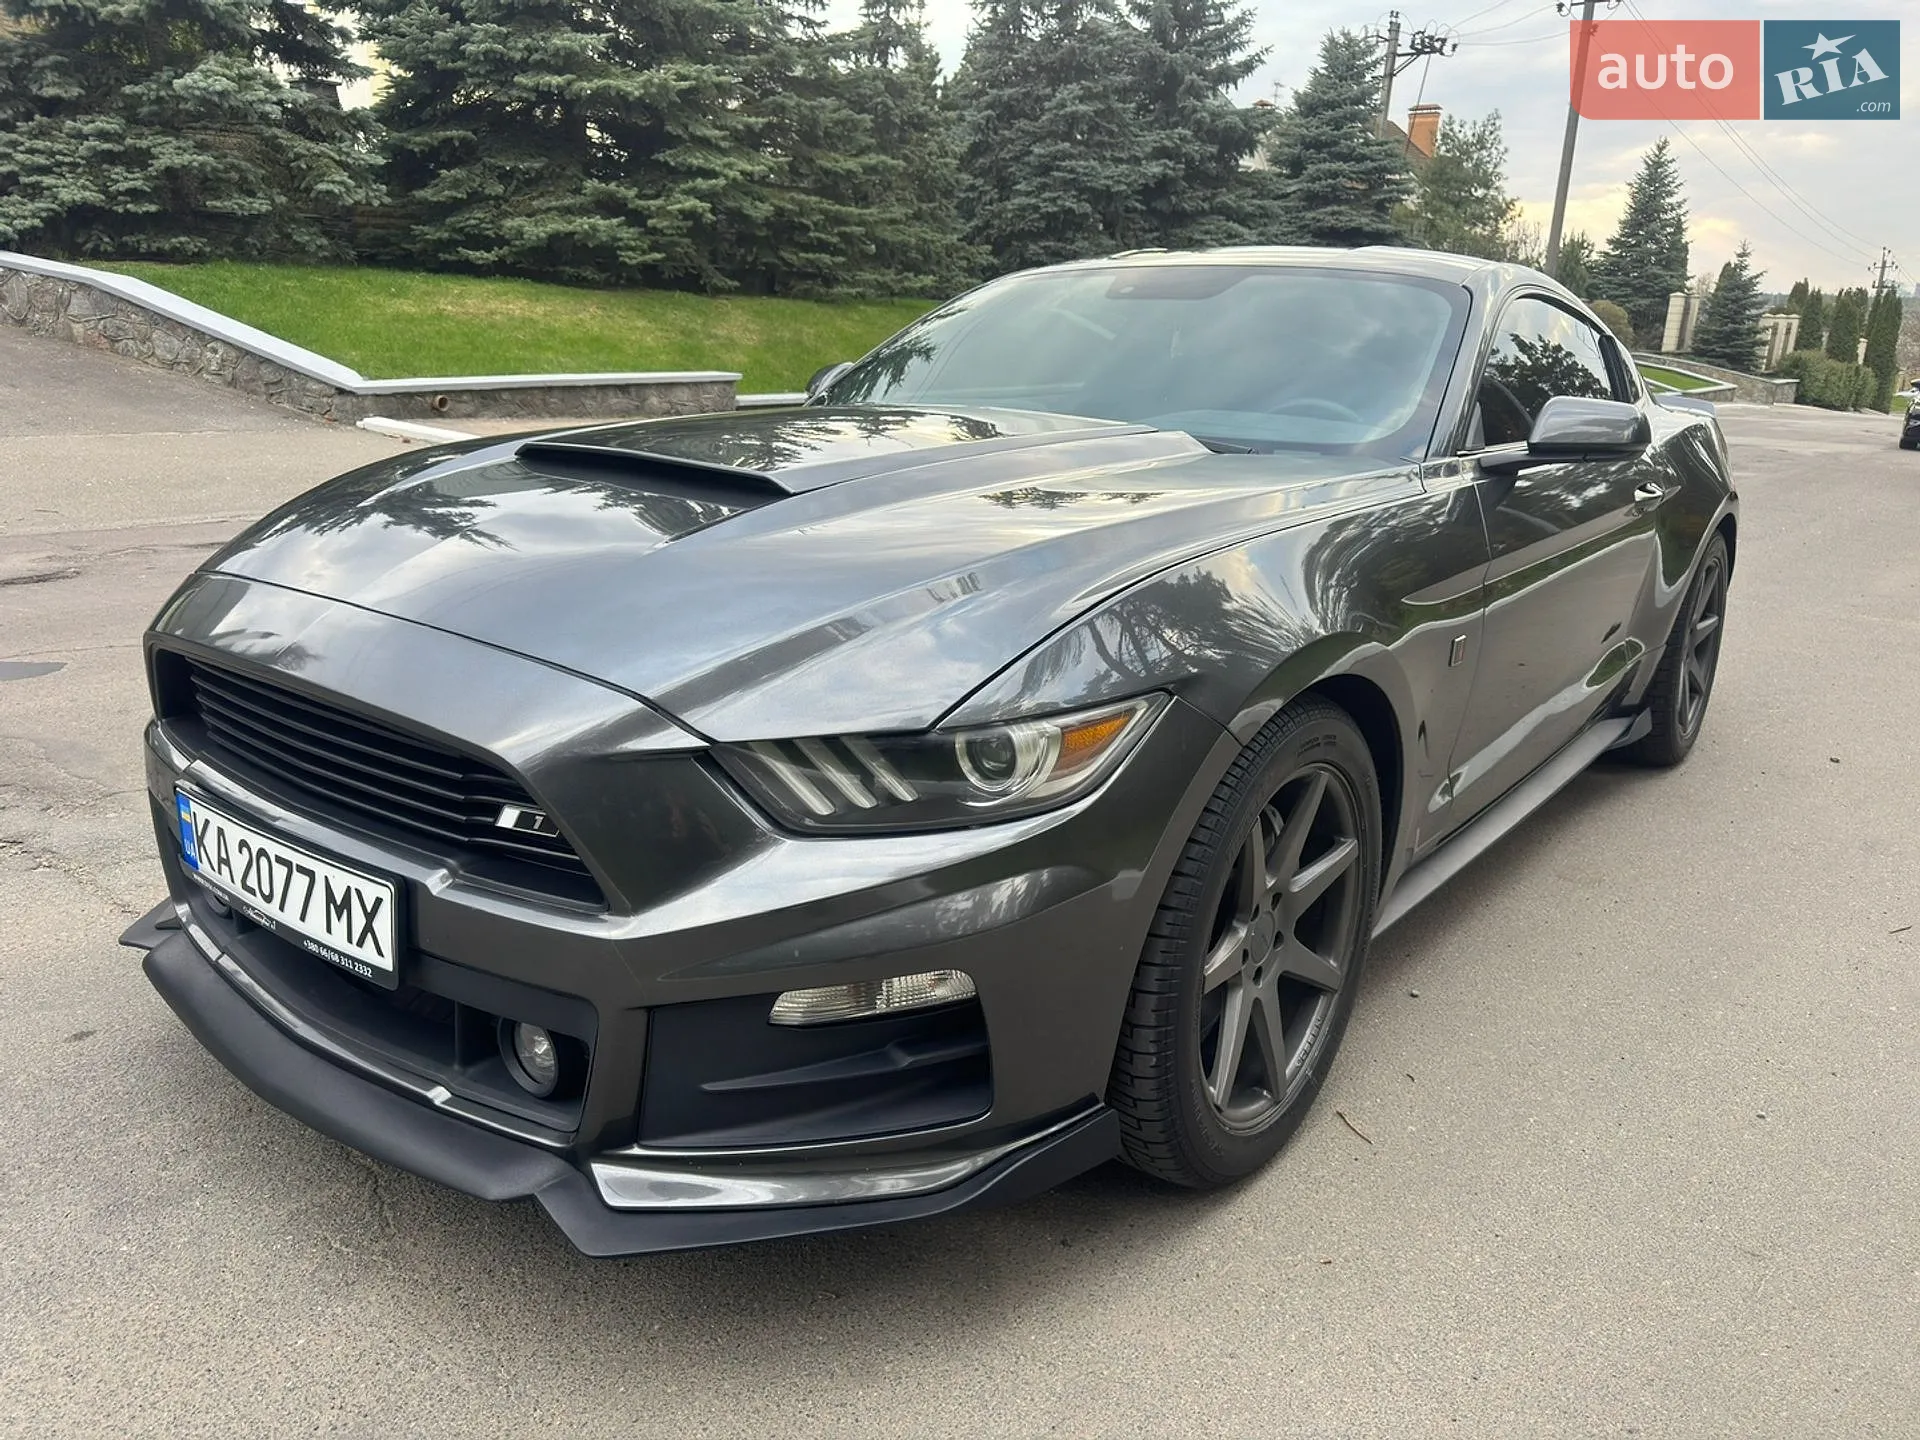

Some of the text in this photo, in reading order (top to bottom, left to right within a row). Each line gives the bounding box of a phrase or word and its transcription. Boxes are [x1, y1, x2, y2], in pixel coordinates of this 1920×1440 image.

[184, 838, 197, 859] UA
[192, 811, 385, 958] KA 2077 MX
[340, 955, 354, 969] 311
[354, 961, 373, 978] 2332
